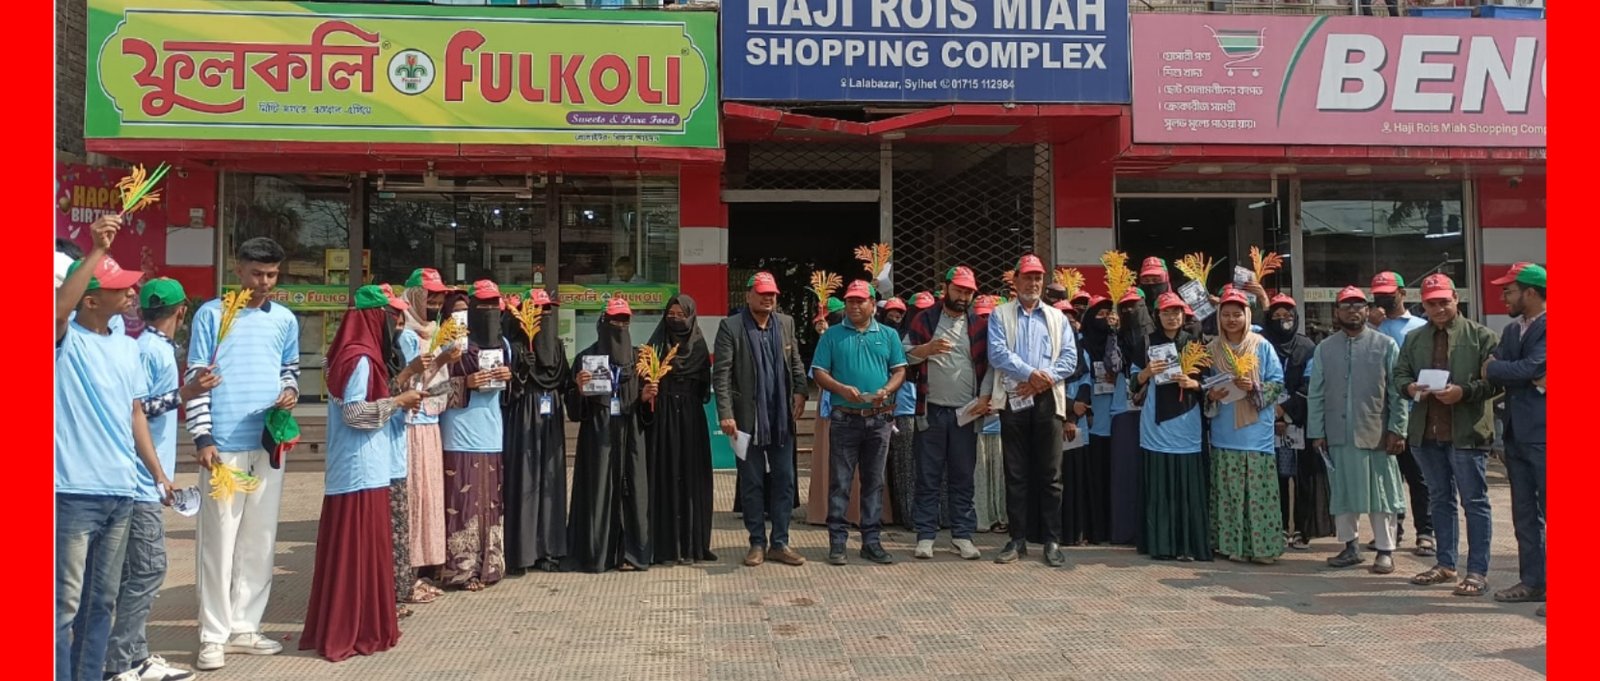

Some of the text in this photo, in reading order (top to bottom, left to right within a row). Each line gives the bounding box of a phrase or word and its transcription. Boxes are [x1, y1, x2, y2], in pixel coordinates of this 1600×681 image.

[748, 0, 1107, 32] HAJI ROIS MIAH
[443, 29, 681, 106] FULKOLI
[745, 38, 1107, 70] SHOPPING COMPLEX
[121, 20, 381, 117] ফুলকলি
[1315, 32, 1546, 114] BEN
[849, 78, 1015, 90] Lalabazar, Sylhet 01715 112984
[571, 113, 677, 125] Sweets & Pure Food
[1393, 122, 1415, 135] Haji
[1416, 122, 1440, 133] Rois
[1441, 122, 1467, 133] Miah
[1468, 123, 1519, 136] Shopping
[73, 185, 122, 210] HAPP
[306, 290, 349, 304] FULKO
